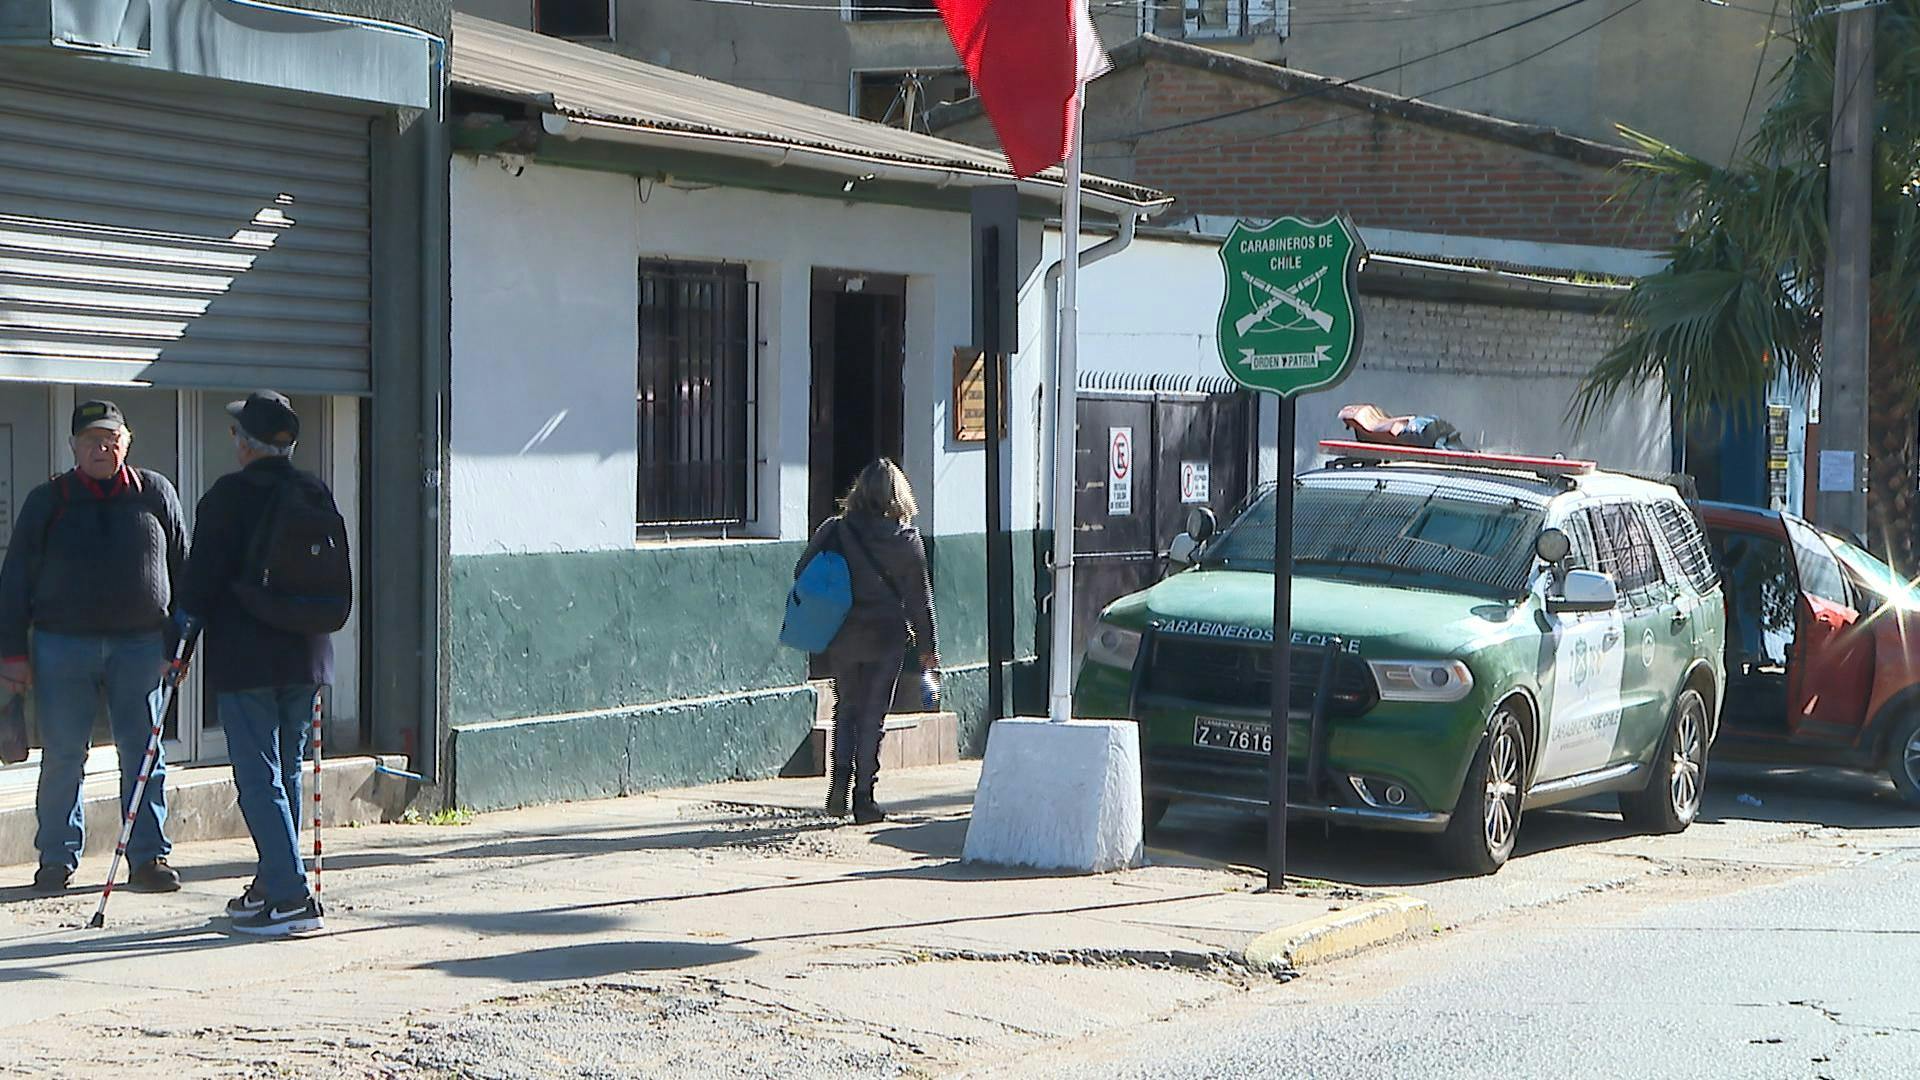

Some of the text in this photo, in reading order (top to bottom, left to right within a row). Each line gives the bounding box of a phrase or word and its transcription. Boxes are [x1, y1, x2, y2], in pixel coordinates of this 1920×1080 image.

[1240, 234, 1333, 254] CARABINEROS DE
[1270, 256, 1302, 270] CHILE
[1253, 355, 1316, 368] ORDEN Y PATRIA
[1198, 726, 1272, 752] Z 7616
